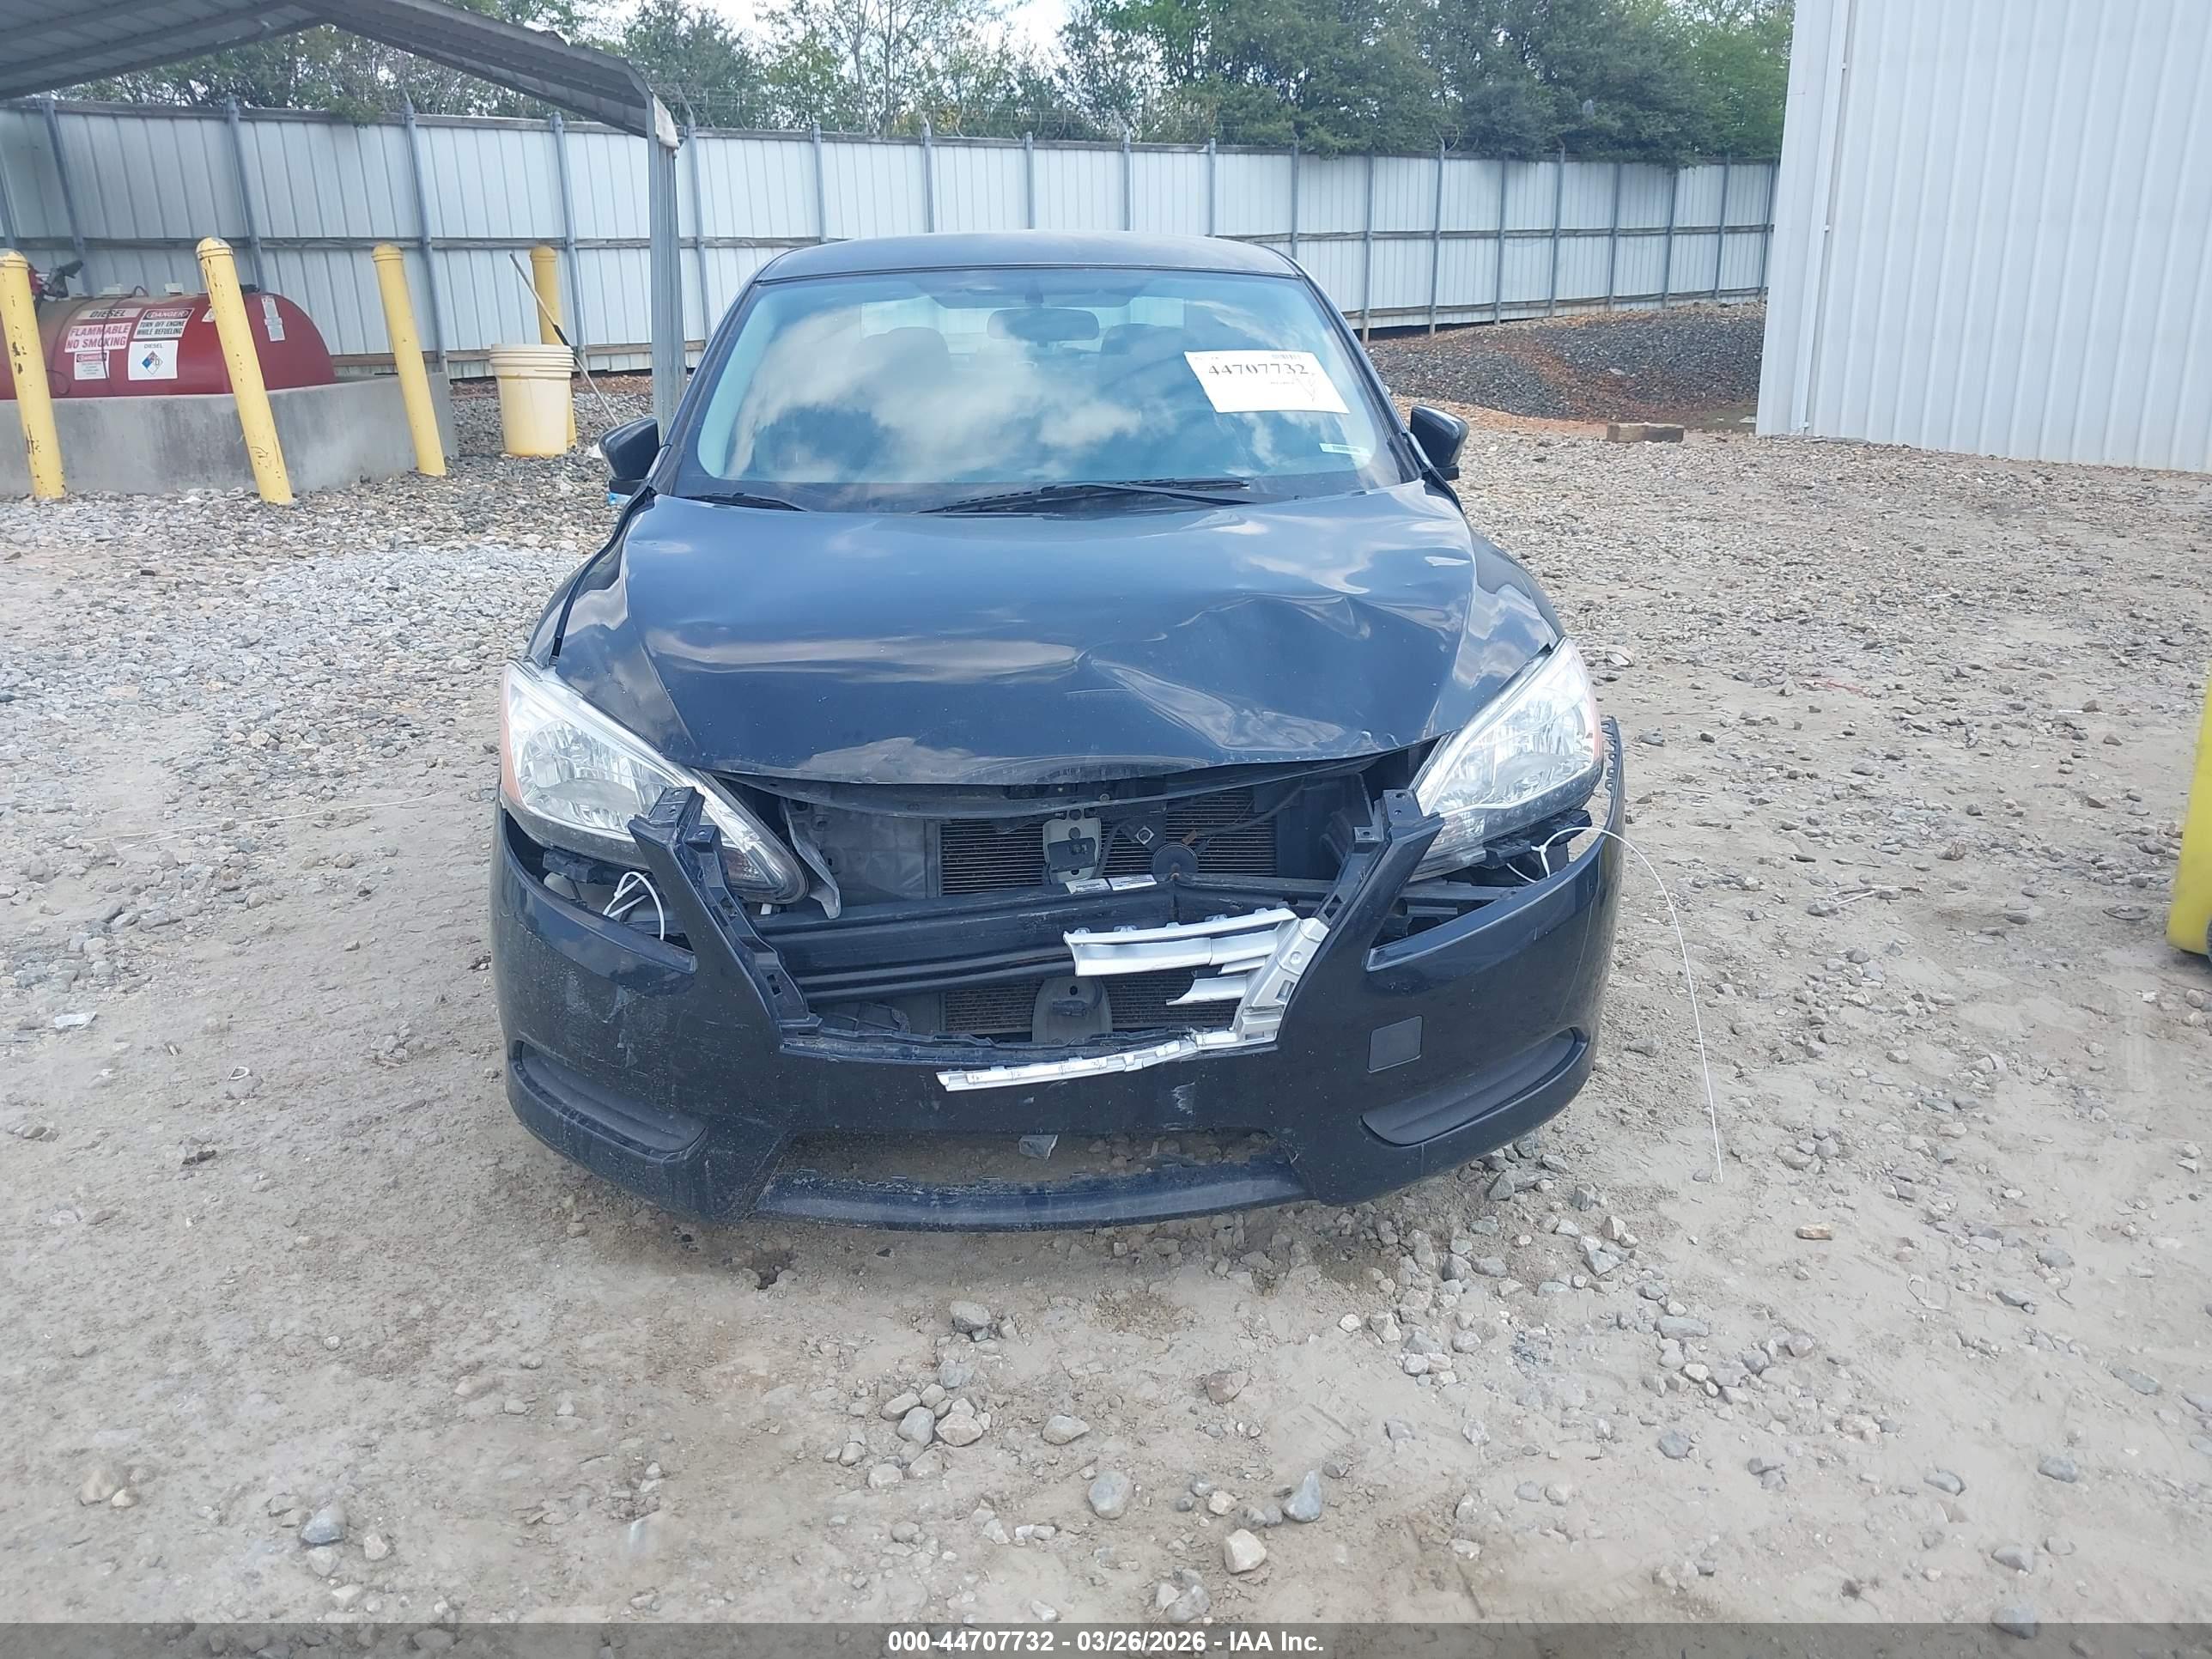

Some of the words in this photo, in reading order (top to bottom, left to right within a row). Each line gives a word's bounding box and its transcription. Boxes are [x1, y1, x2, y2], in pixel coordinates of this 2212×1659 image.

[89, 309, 126, 318] DIESEL
[70, 325, 131, 337] FLAMMABLE
[66, 339, 80, 349] NO
[82, 336, 127, 349] SMOKING
[1208, 363, 1309, 375] 44707732
